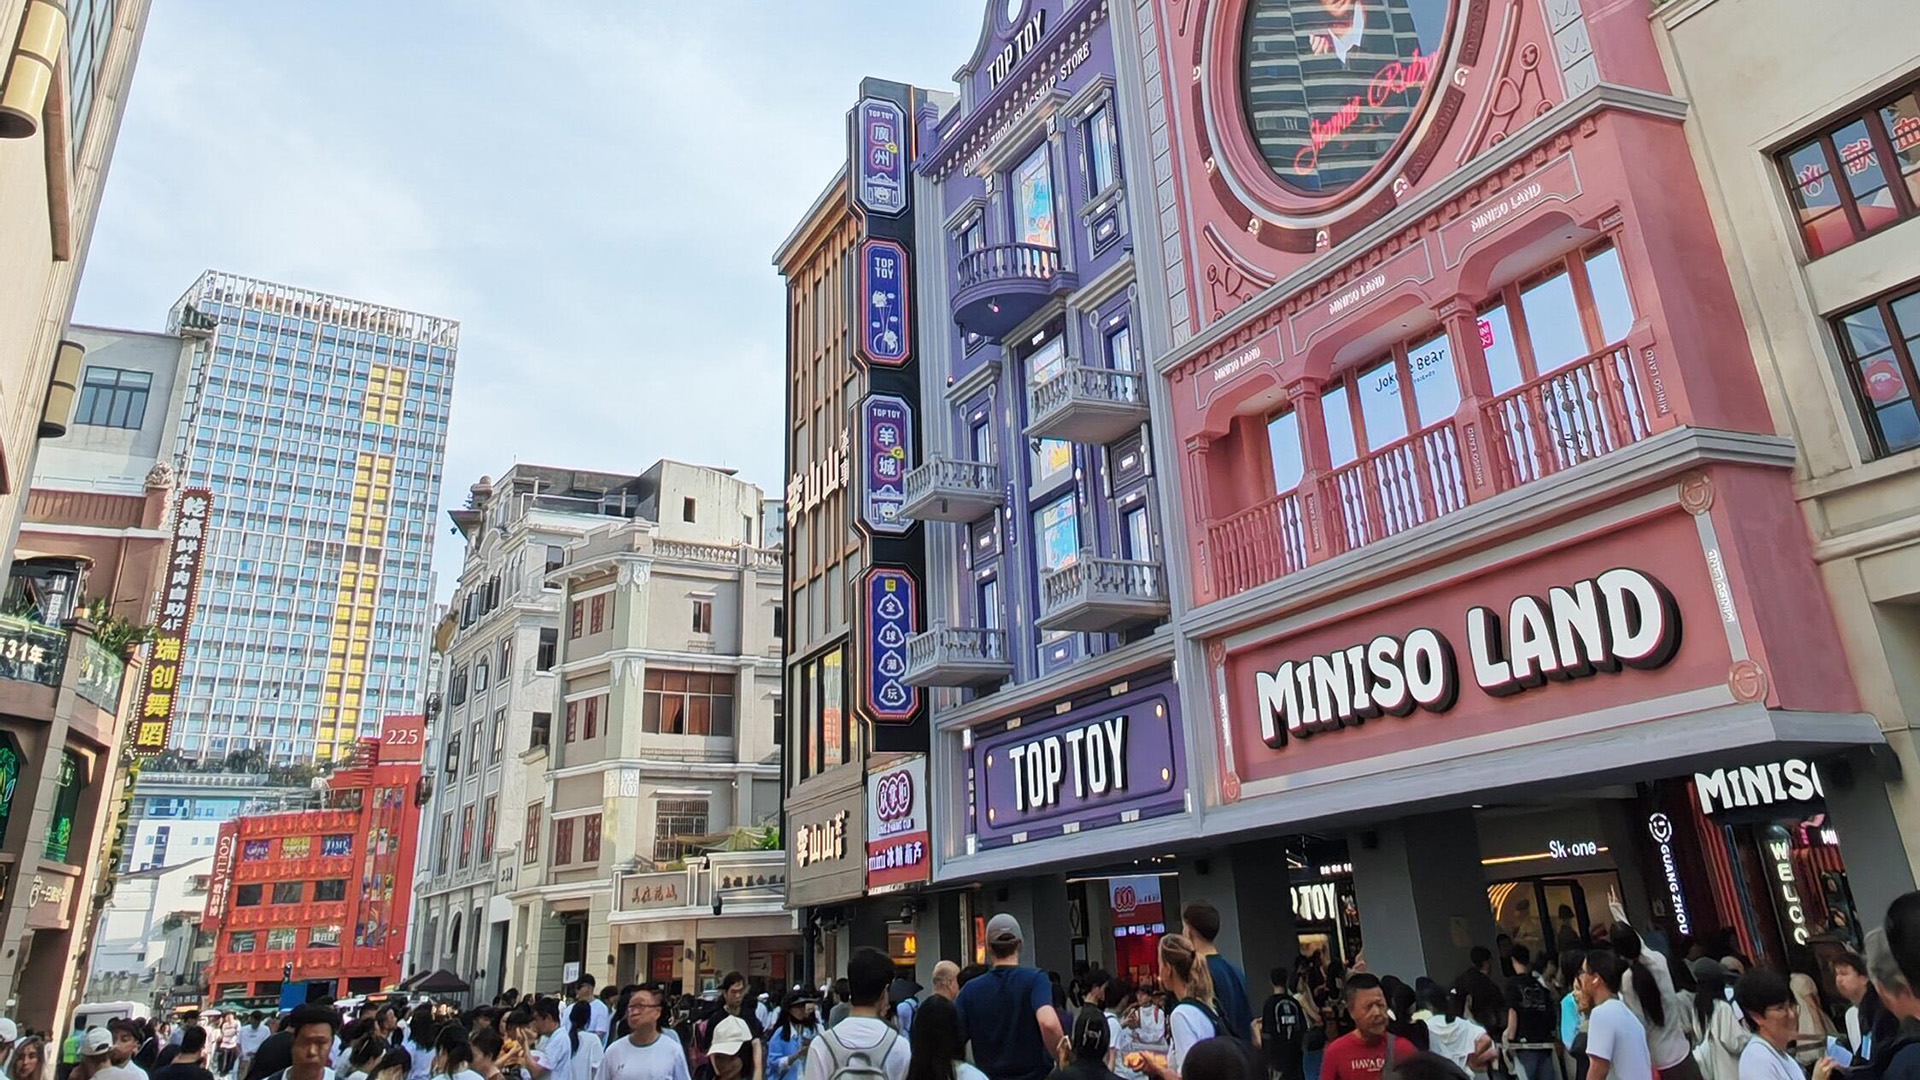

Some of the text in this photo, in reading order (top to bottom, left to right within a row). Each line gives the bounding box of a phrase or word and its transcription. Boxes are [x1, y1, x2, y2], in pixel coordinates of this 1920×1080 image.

[986, 9, 1045, 90] TOP TOY
[1060, 41, 1091, 81] STORE
[868, 109, 893, 119] TOP TOY
[873, 124, 891, 169] 廣州
[1470, 183, 1541, 232] MINISO LAND
[874, 257, 894, 269] TOP
[875, 267, 894, 280] TOY
[1329, 274, 1385, 315] MINISO LAND
[1214, 346, 1261, 382] MINISO LAND
[1416, 349, 1445, 371] Bear
[1646, 349, 1669, 414] MINISO LAND
[872, 406, 901, 419] TOP TOY
[877, 425, 897, 478] 羊城
[786, 445, 840, 528] 李山山
[884, 600, 899, 701] 全球潮玩
[1255, 567, 1674, 745] MINISO LAND
[137, 637, 180, 746] 瑞创舞蹈
[385, 728, 419, 746] 225
[1008, 716, 1127, 812] TOP TOY
[1694, 759, 1825, 815] MINIS
[797, 820, 835, 868] 李山山
[1298, 882, 1336, 921] TOY
